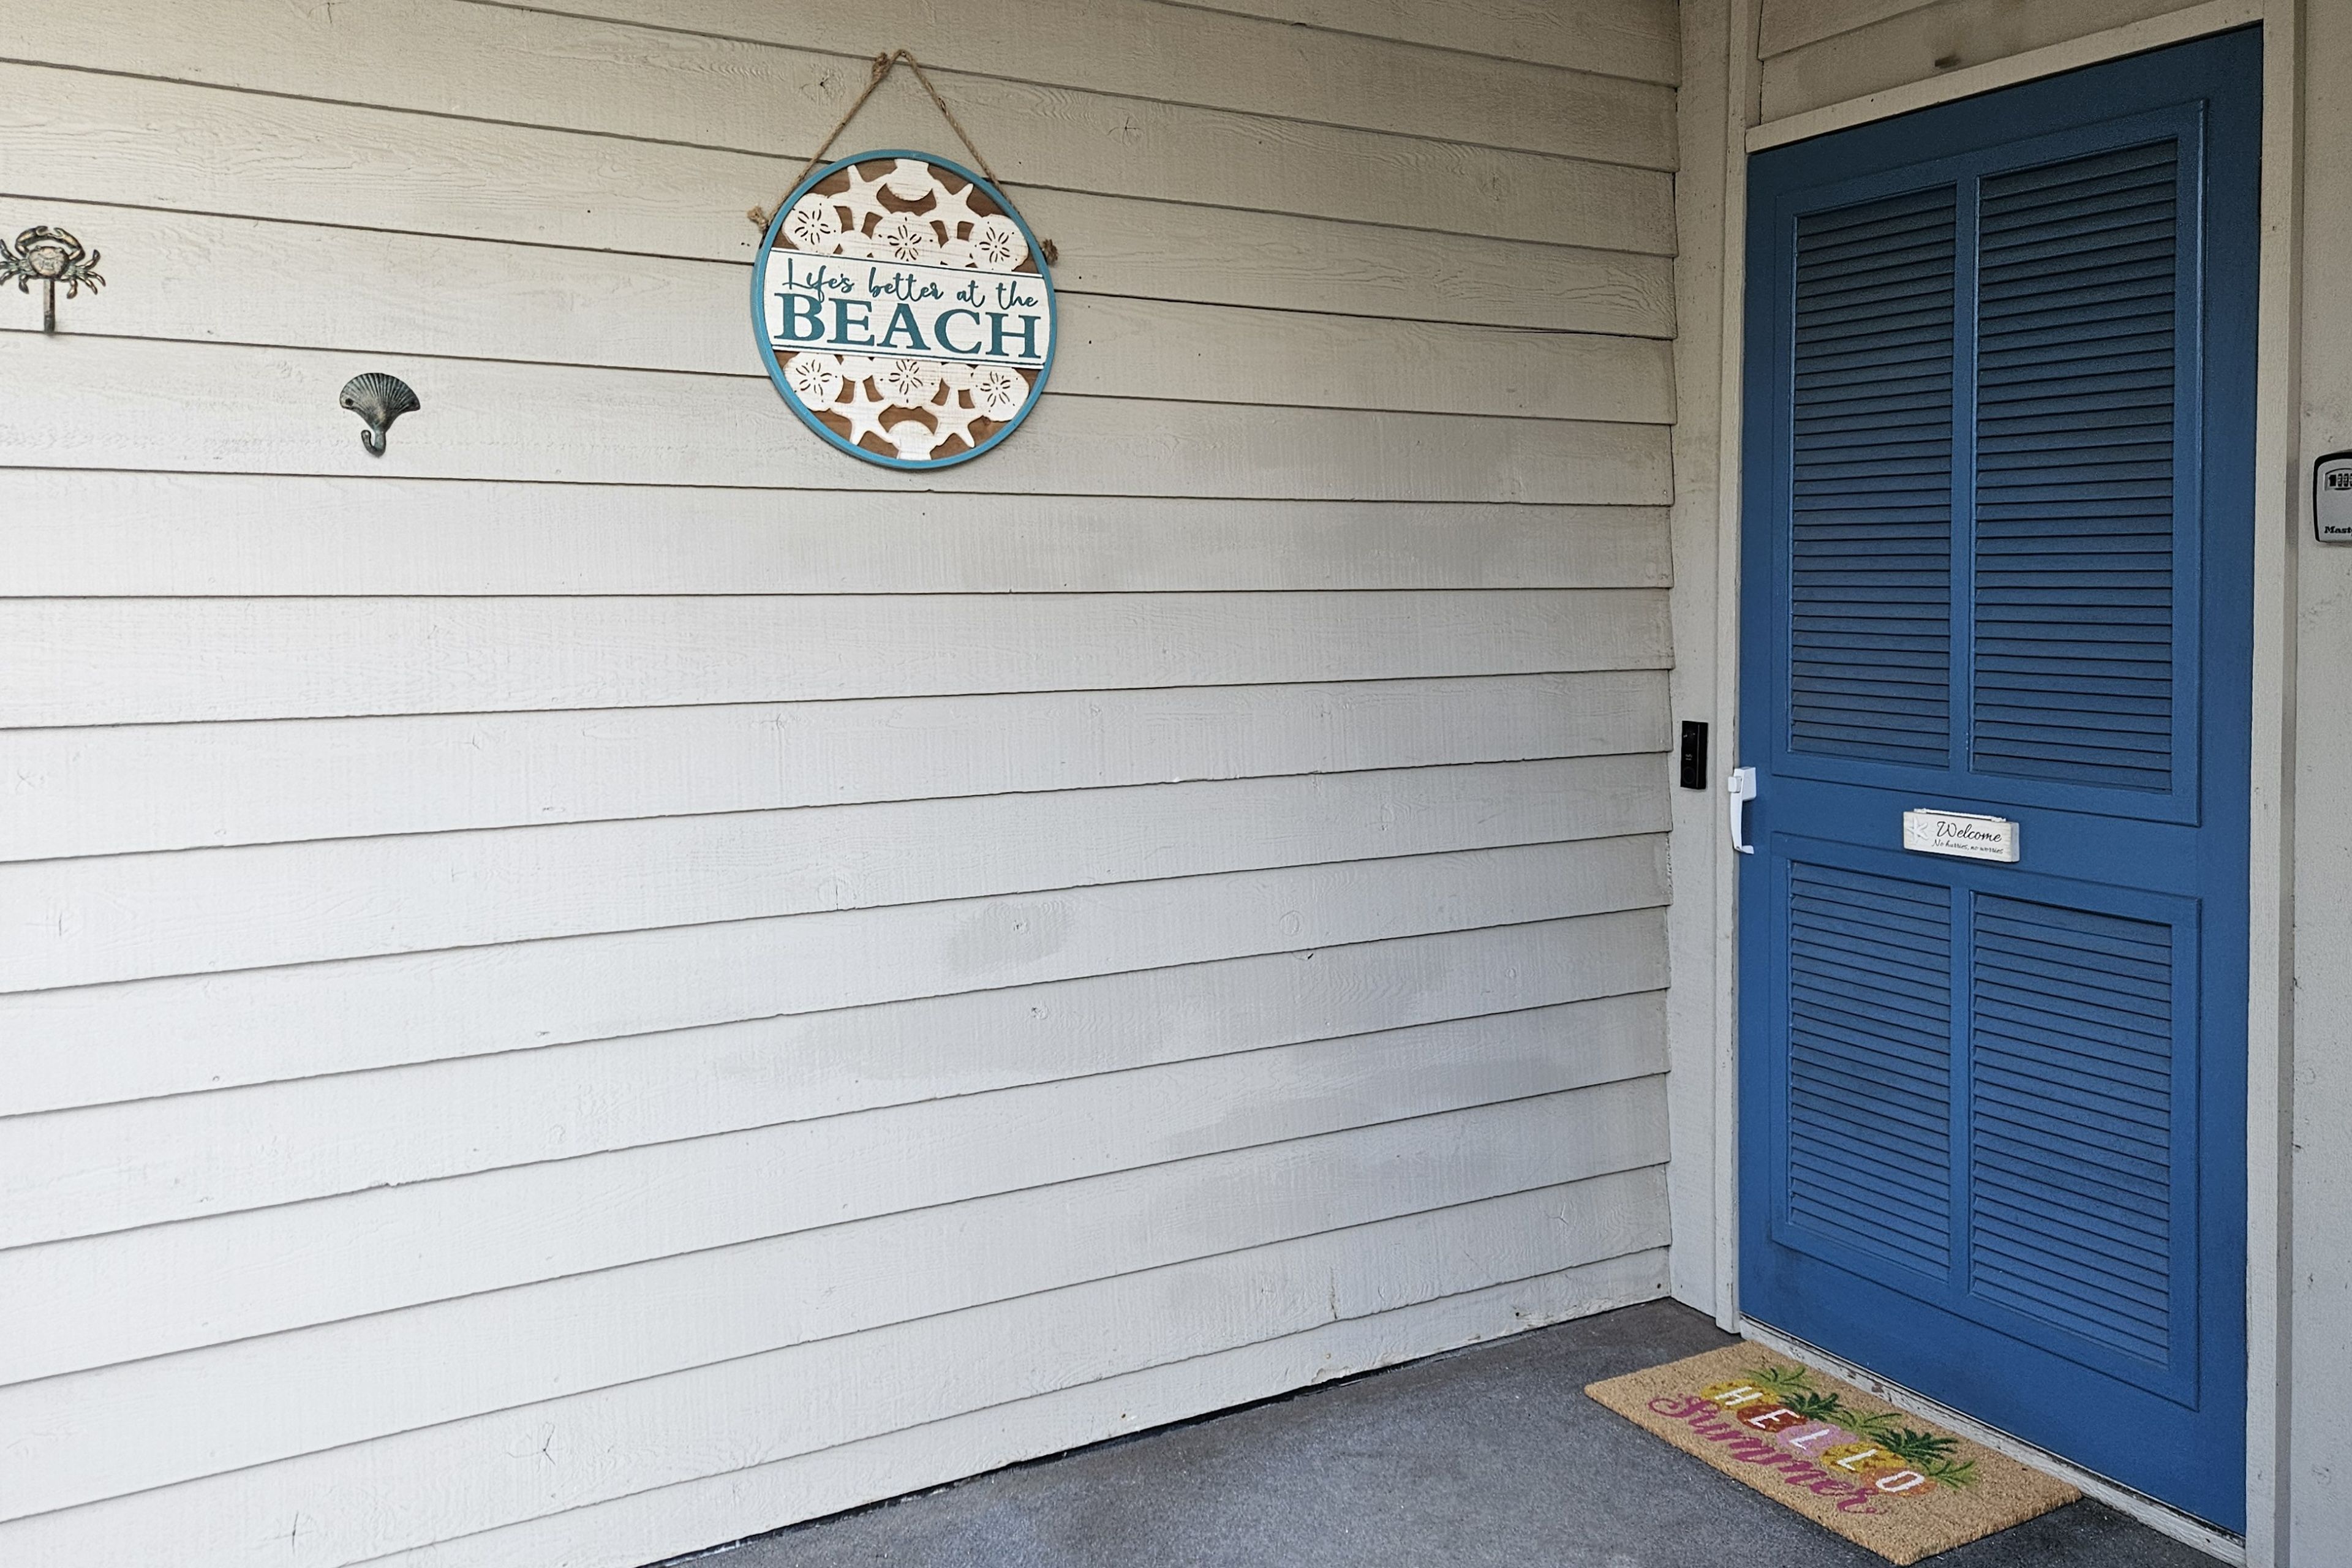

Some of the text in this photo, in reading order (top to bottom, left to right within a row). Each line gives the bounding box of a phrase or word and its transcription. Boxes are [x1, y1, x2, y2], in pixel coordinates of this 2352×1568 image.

[782, 257, 1039, 311] Life's better at the
[774, 292, 1042, 360] BEACH
[1932, 839, 1943, 847] No
[1945, 840, 1970, 851] hurries,
[1937, 821, 2002, 843] Welcome
[1648, 1393, 1888, 1515] Summer
[1714, 1385, 1926, 1493] HELLO
